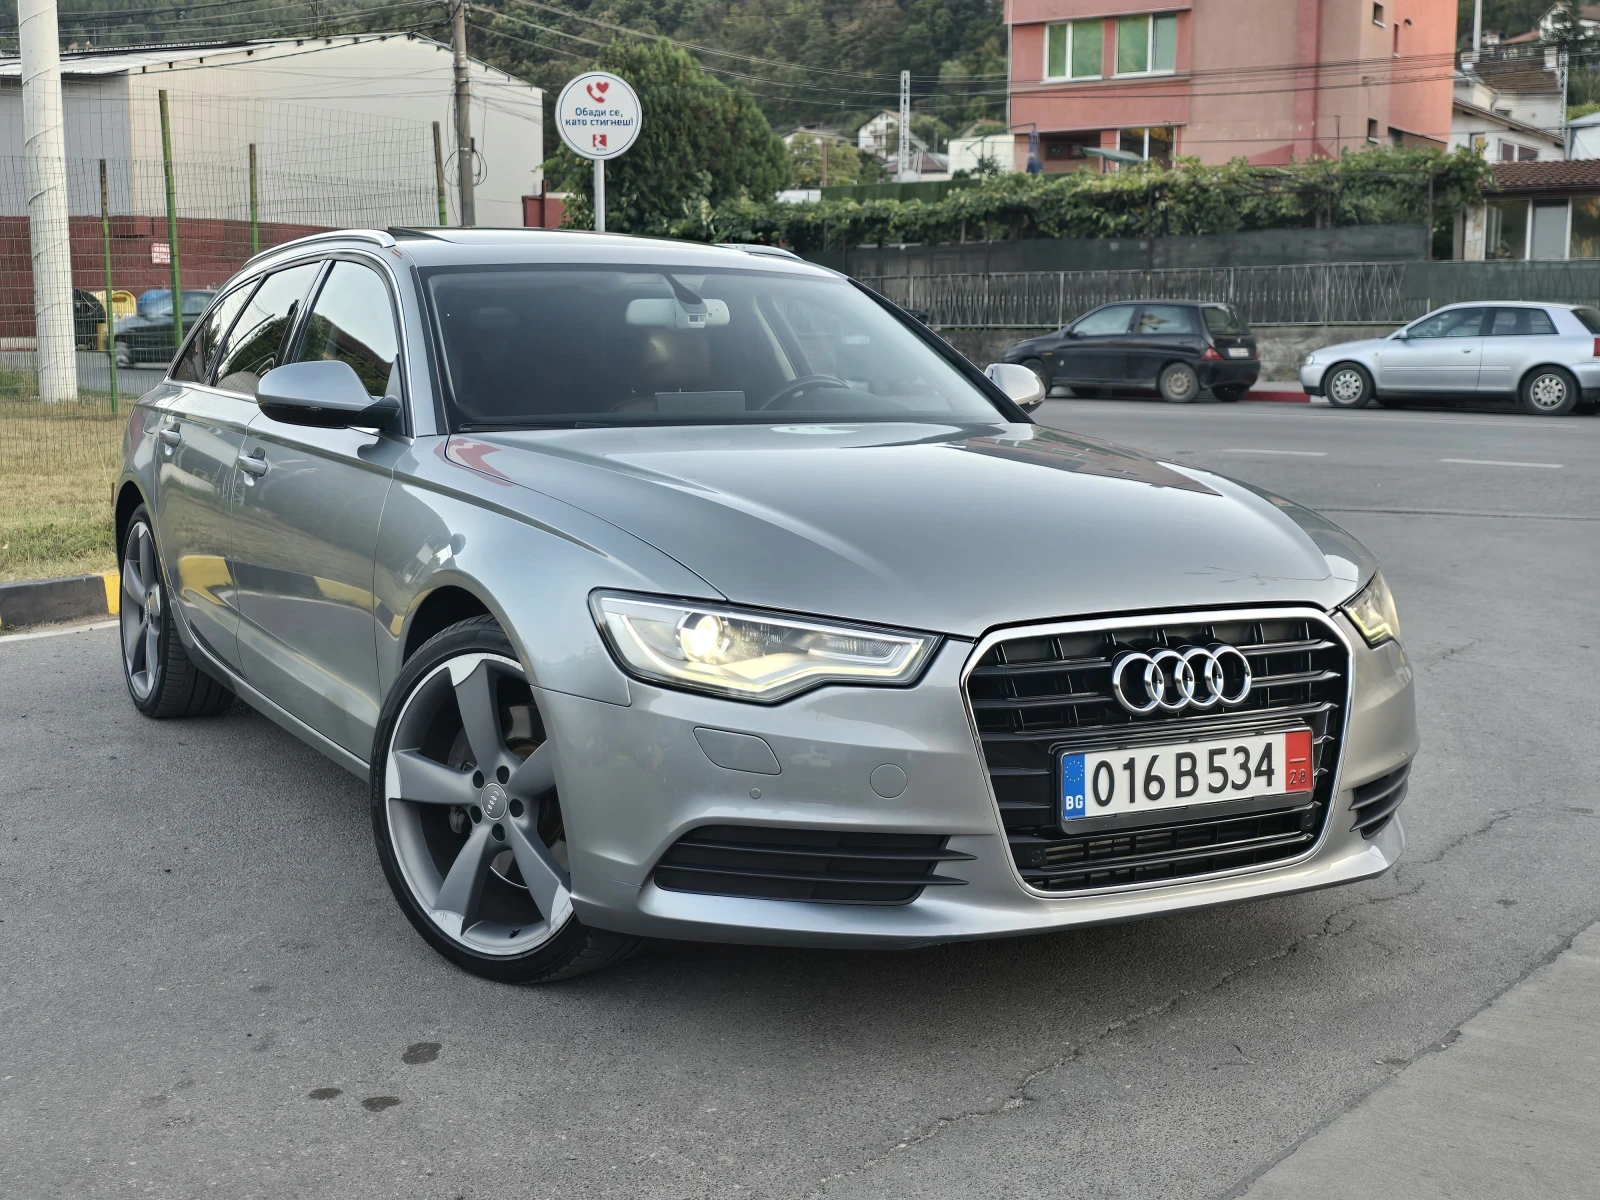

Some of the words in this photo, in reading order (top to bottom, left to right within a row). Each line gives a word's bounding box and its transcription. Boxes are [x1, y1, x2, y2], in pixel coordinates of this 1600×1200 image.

[575, 107, 607, 117] Обади
[609, 109, 623, 117] се,
[590, 117, 634, 126] стигнеш!
[1290, 769, 1307, 784] 28
[1066, 794, 1083, 810] BG
